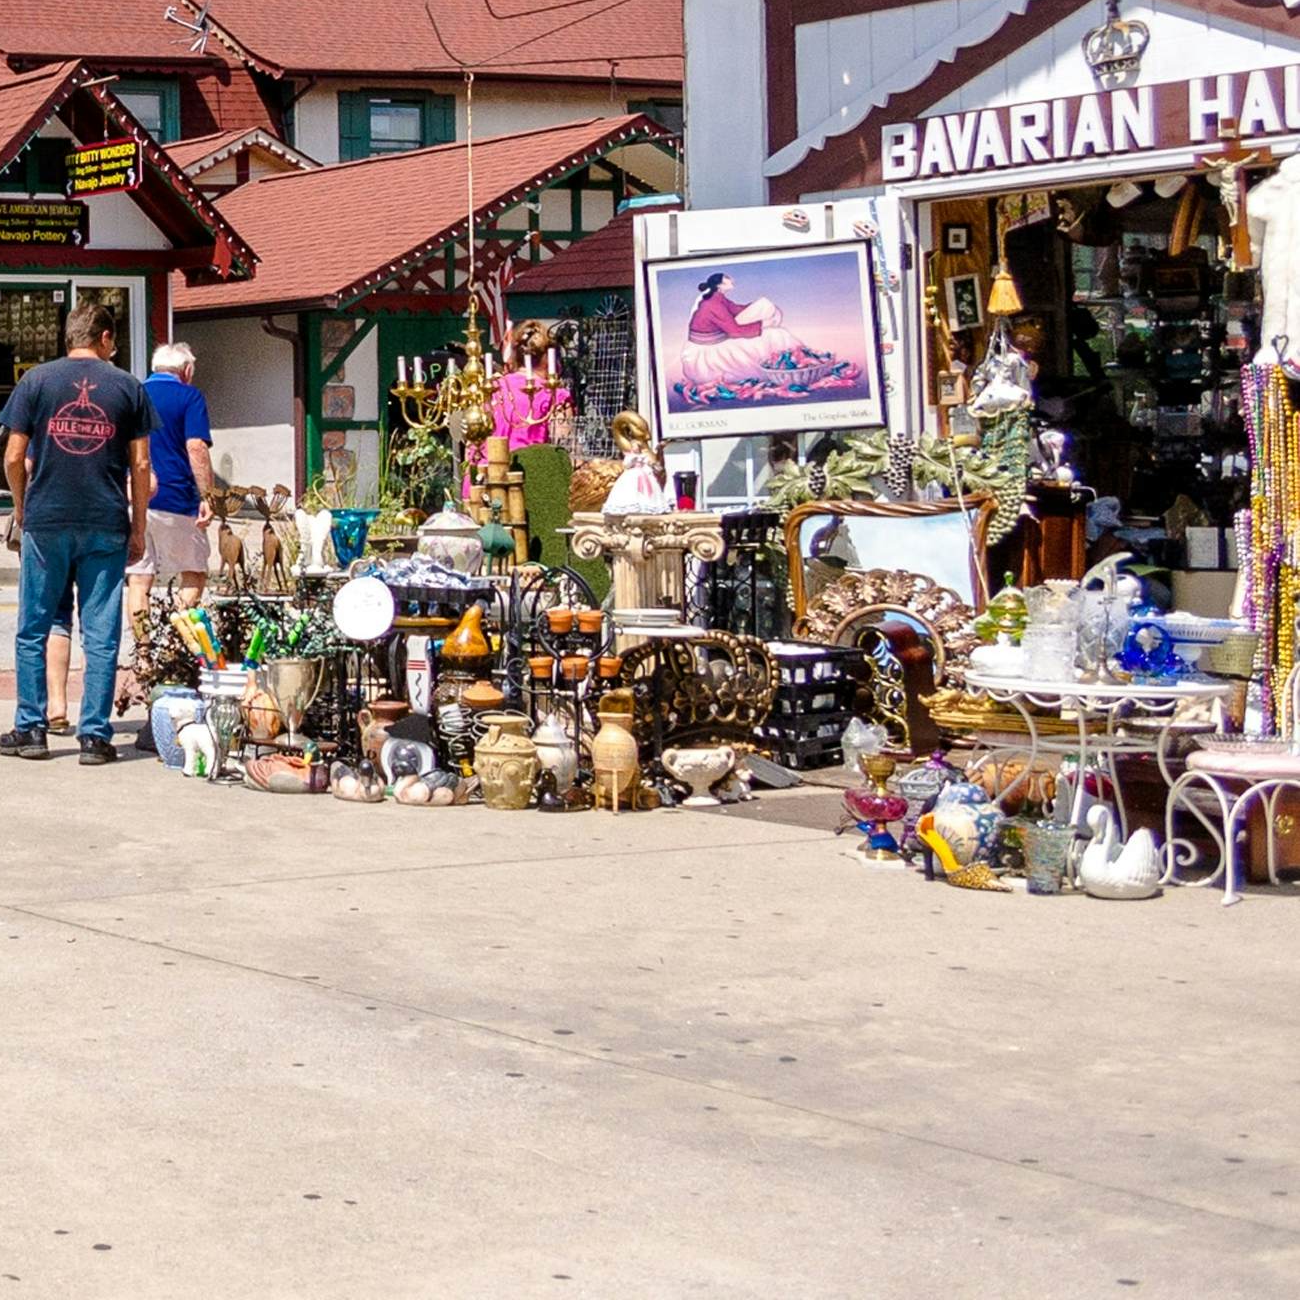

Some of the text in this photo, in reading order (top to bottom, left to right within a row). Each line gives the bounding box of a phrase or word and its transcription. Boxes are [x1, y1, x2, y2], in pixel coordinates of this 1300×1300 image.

[882, 87, 1153, 181] BAVARIAN
[100, 143, 136, 161] WONDERS
[99, 172, 126, 187] Jewelry
[8, 203, 49, 215] AMERICAN
[33, 230, 68, 243] Pottery
[49, 420, 77, 433] RULE
[92, 424, 112, 436] AIR
[686, 420, 729, 431] GORMAN
